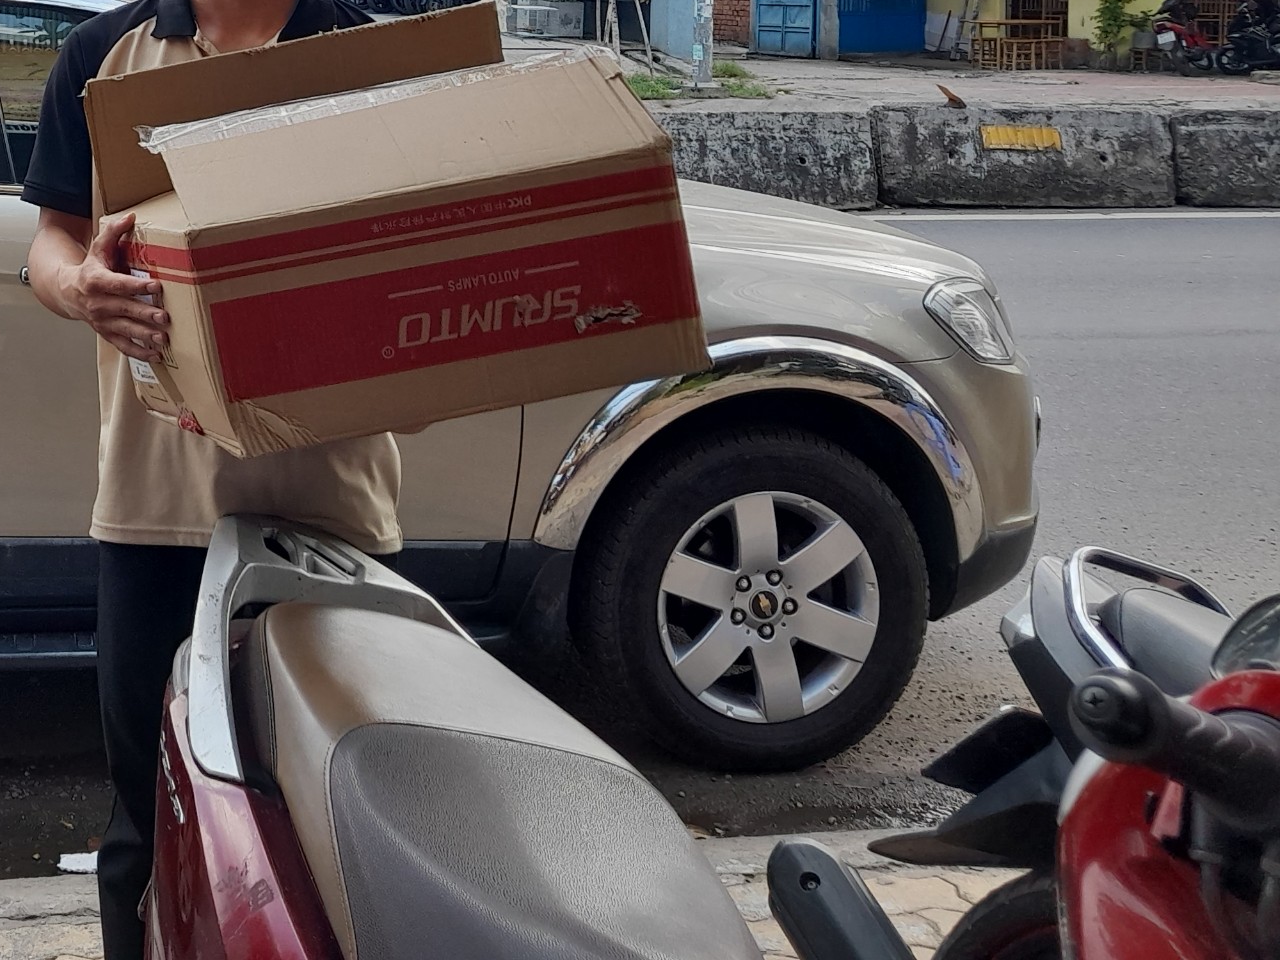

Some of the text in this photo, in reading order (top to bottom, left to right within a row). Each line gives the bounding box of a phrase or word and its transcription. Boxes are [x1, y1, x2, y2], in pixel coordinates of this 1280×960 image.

[447, 267, 520, 291] AUTO LAMPS
[398, 285, 581, 349] SRUMTO
